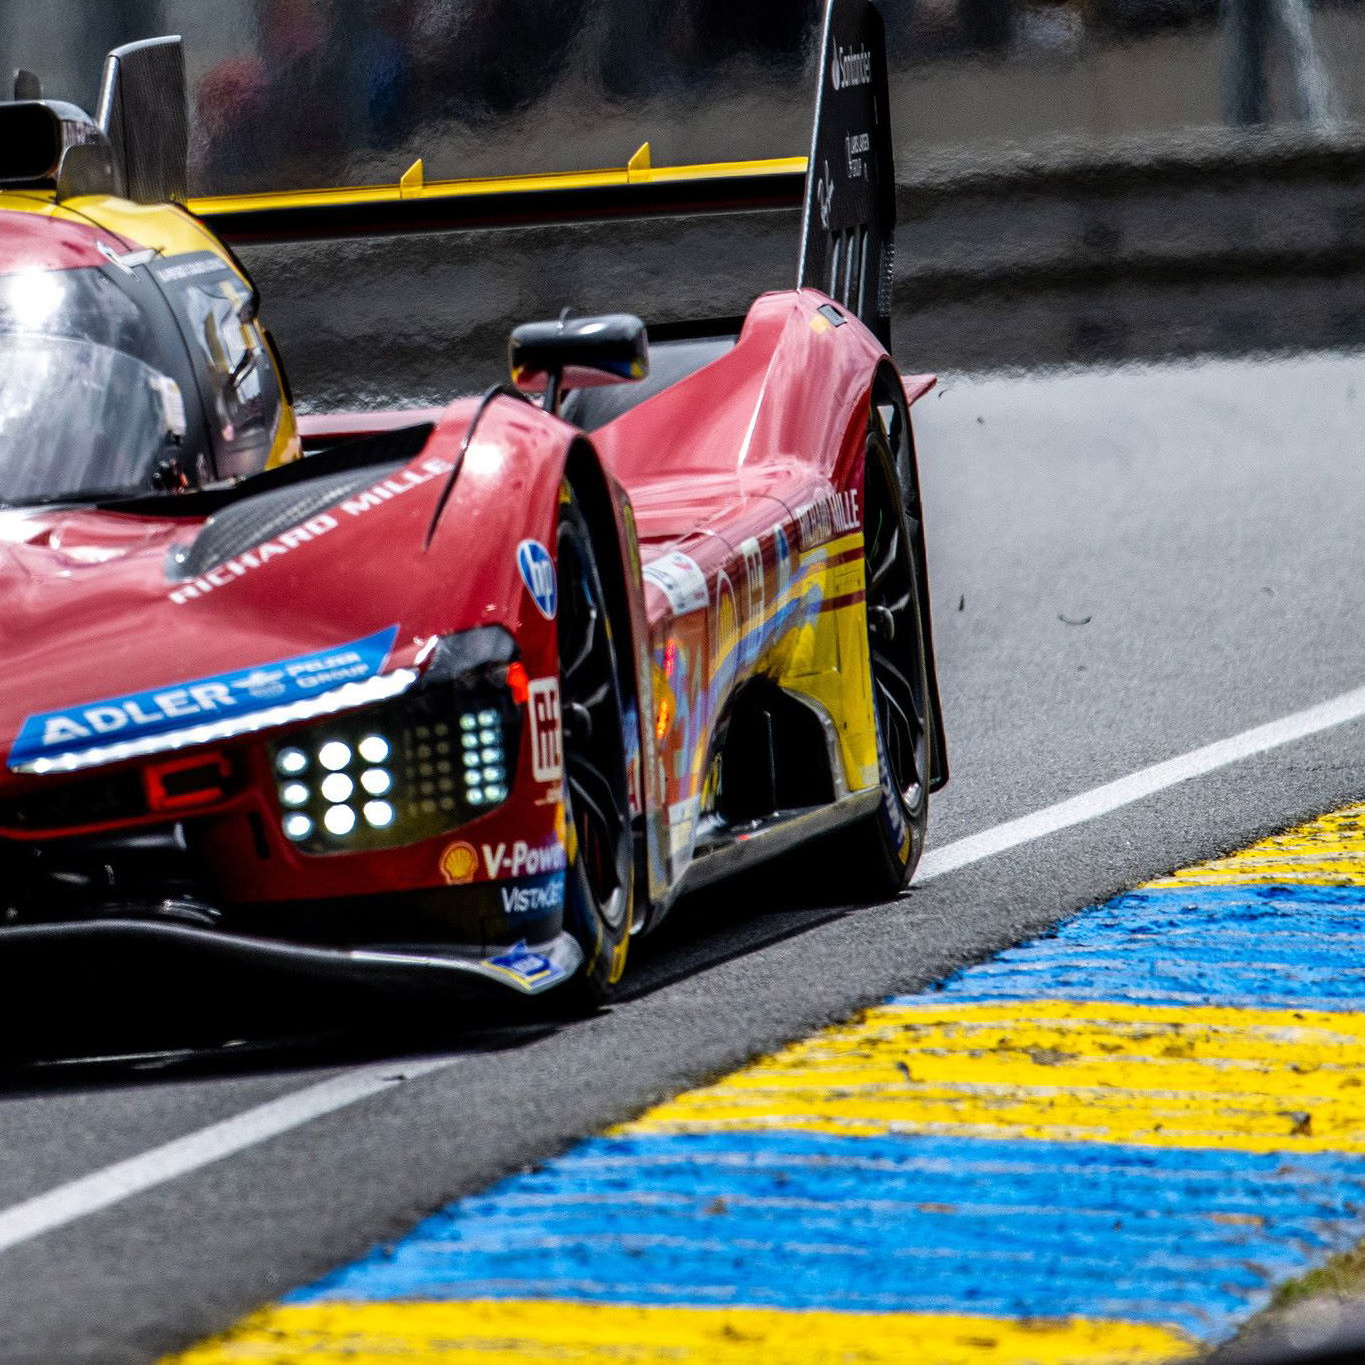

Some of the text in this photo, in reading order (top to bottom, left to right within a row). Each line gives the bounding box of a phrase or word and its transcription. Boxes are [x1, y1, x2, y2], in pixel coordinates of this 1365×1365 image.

[168, 457, 454, 604] RICHARD MILLE
[42, 682, 238, 745] ADLER
